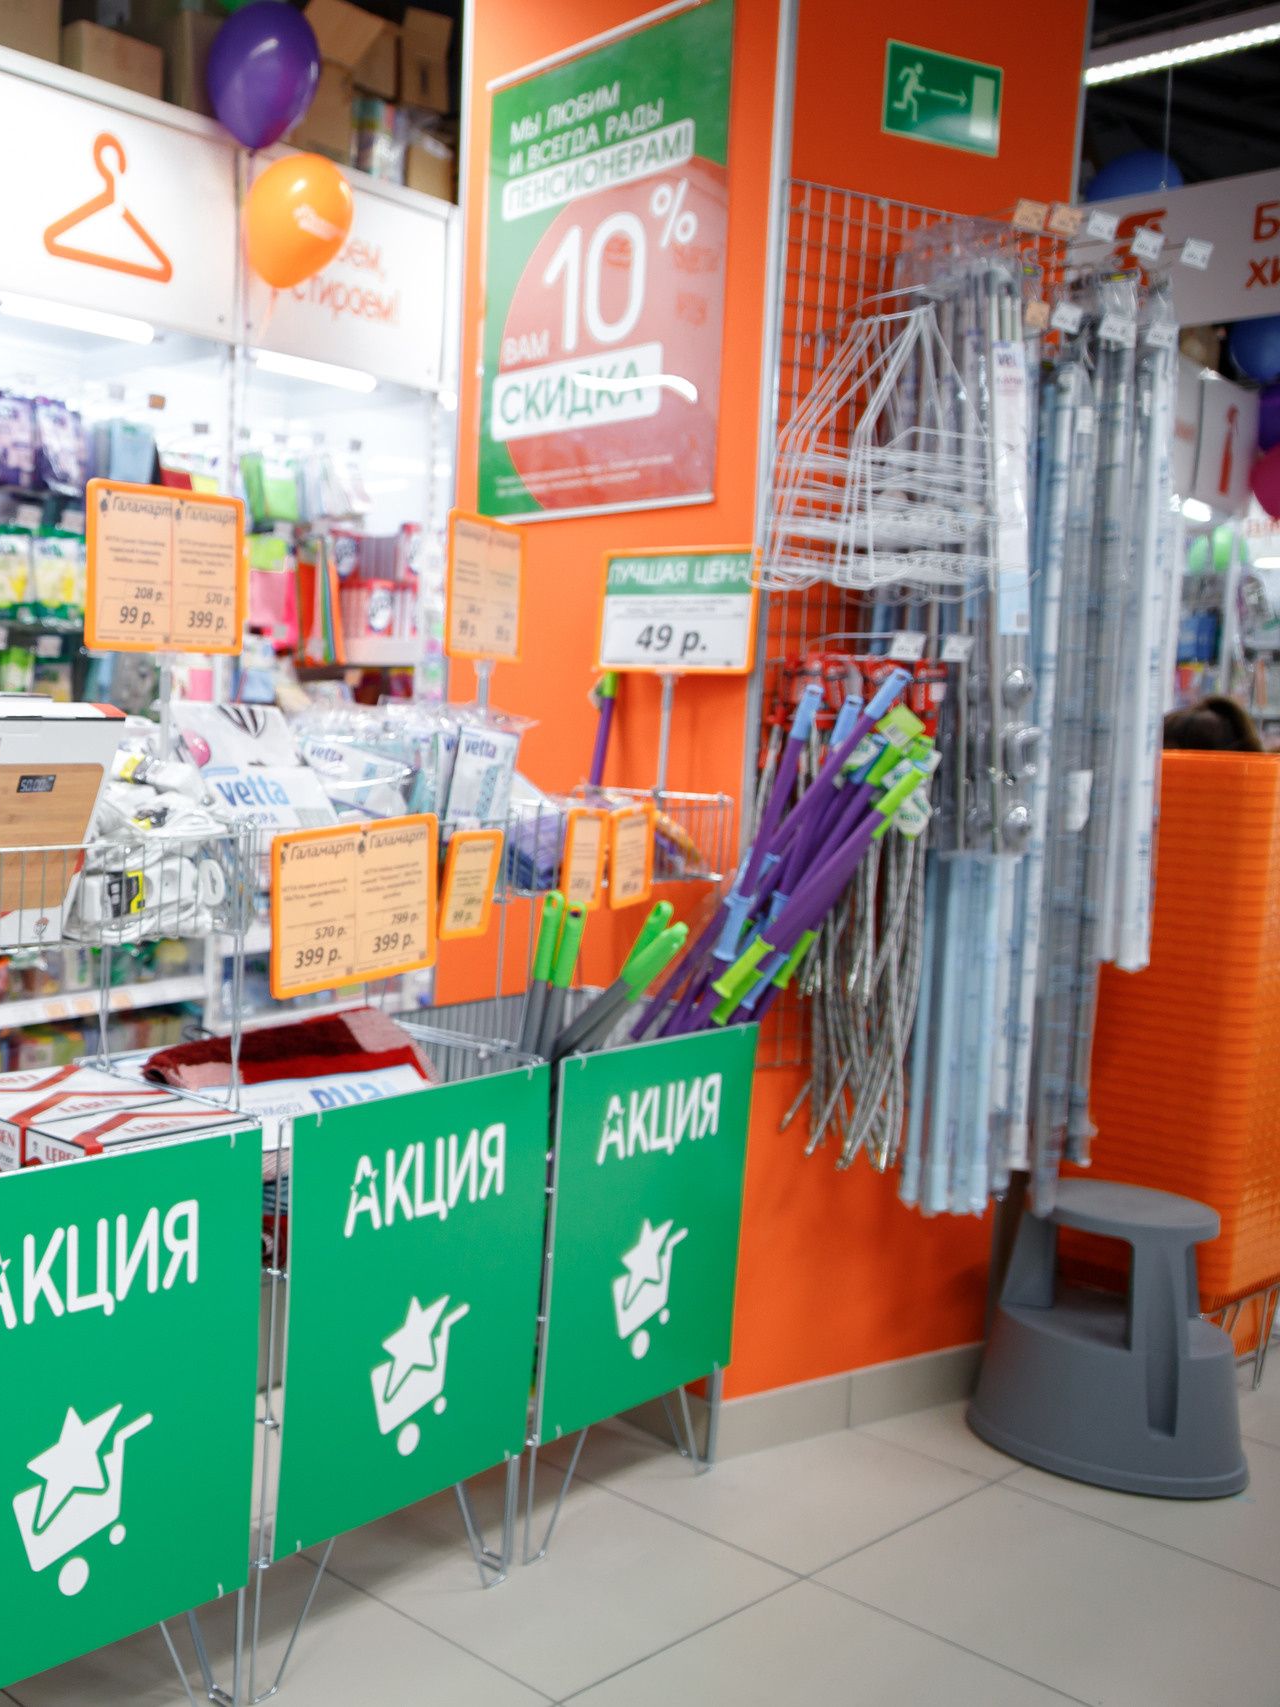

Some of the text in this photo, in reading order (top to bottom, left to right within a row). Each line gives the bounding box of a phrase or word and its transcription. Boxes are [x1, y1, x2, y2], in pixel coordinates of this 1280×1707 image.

[509, 79, 621, 146] МЫ ЛЮБИМ
[508, 97, 664, 177] И ВСЕГДА РАДЫ
[506, 126, 690, 212] ПЕНСИОНЕРАМ!
[503, 329, 550, 366] ВАМ
[500, 359, 643, 425] СКИДКА
[112, 496, 172, 519] Галамарт
[134, 586, 153, 600] 208
[119, 605, 155, 629] 99 р.
[187, 609, 227, 632] 399 р.
[635, 623, 707, 660] 49 р.
[466, 740, 496, 759] vetta
[216, 777, 291, 807] vetta
[289, 840, 355, 861] Галамарт
[370, 829, 428, 850] Галамарт
[314, 925, 336, 940] 570
[372, 931, 415, 954] 399 р.
[294, 946, 342, 969] 399 р.
[595, 1072, 722, 1168] АКЦИЯ
[345, 1121, 508, 1239] АКЦИЯ
